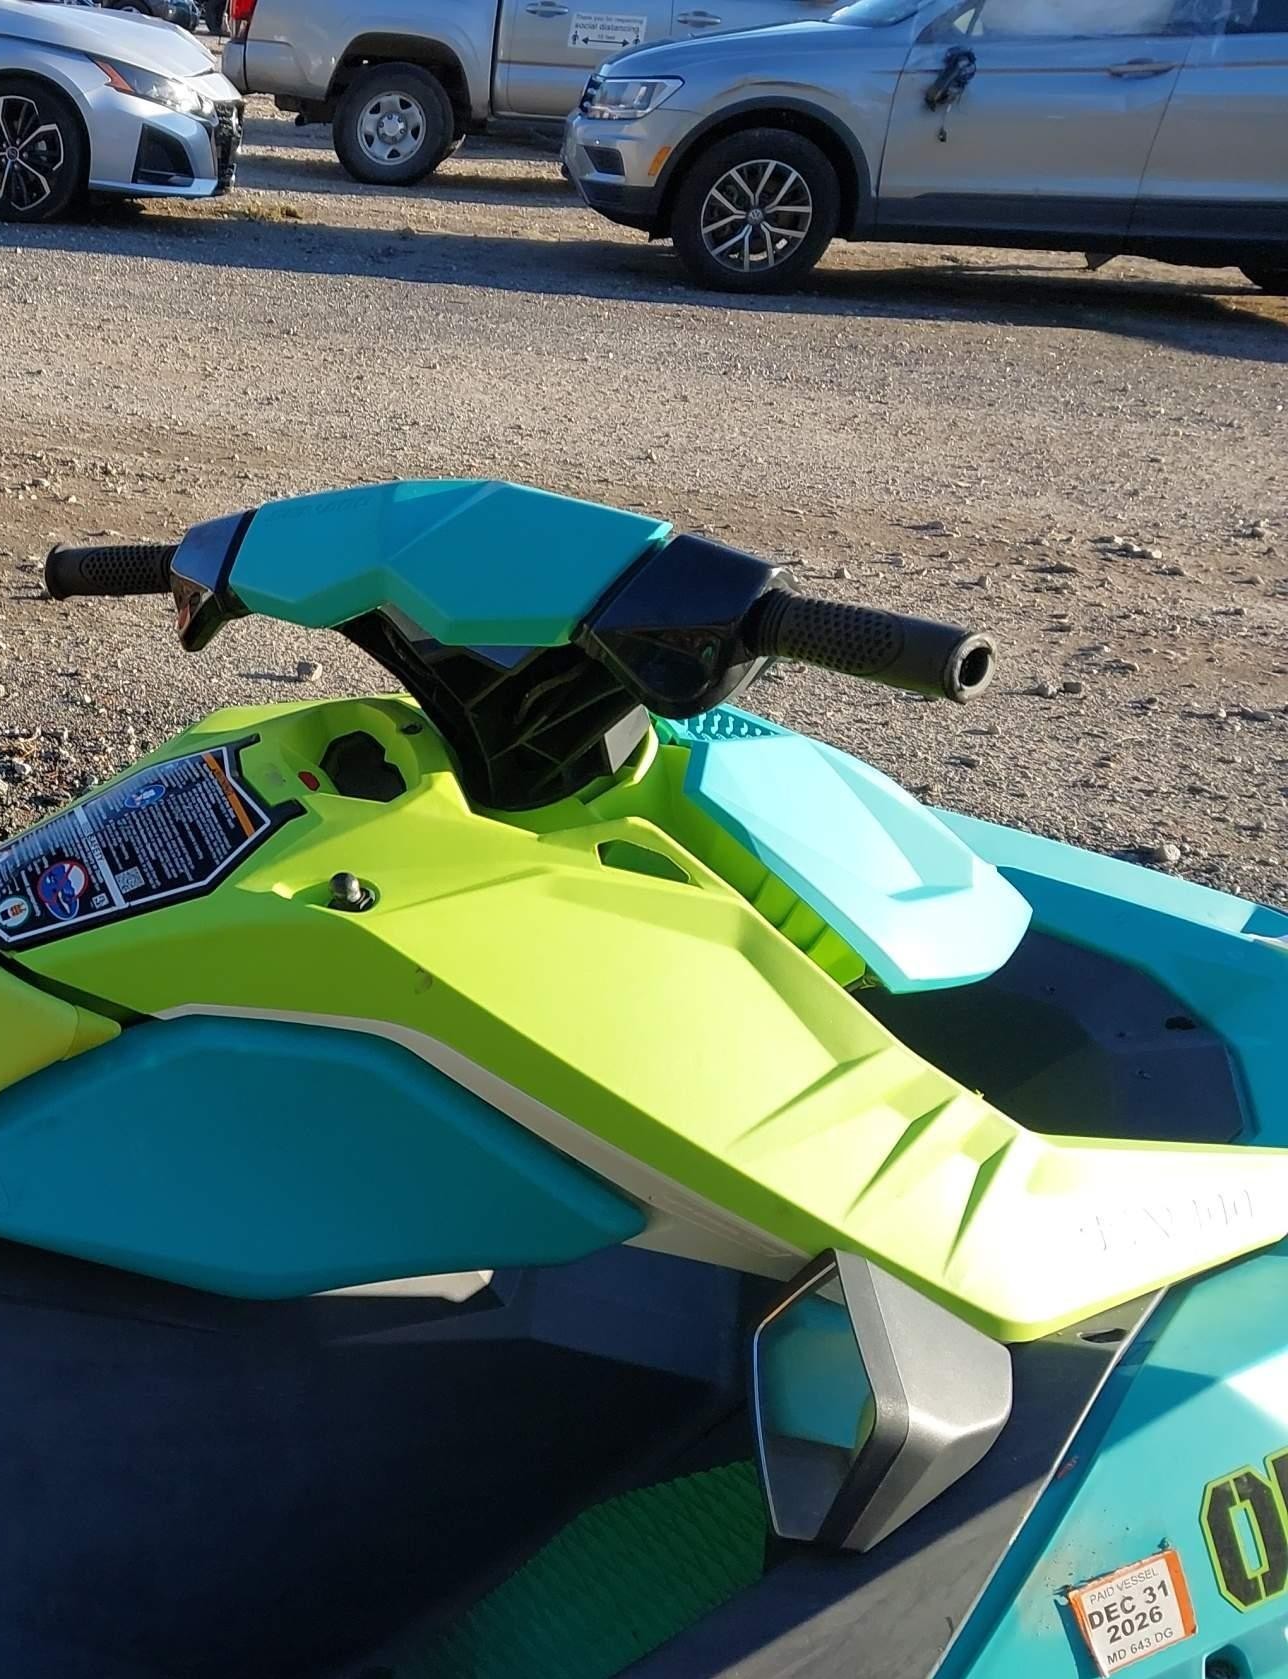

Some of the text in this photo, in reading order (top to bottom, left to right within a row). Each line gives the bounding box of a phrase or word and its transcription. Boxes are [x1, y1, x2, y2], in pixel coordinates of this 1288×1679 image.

[1087, 1579, 1170, 1631] DEC 31
[1088, 1567, 1160, 1605] PAID VESSEL
[1105, 1604, 1164, 1645] 2026
[1106, 1626, 1175, 1666] MD 643 DG
